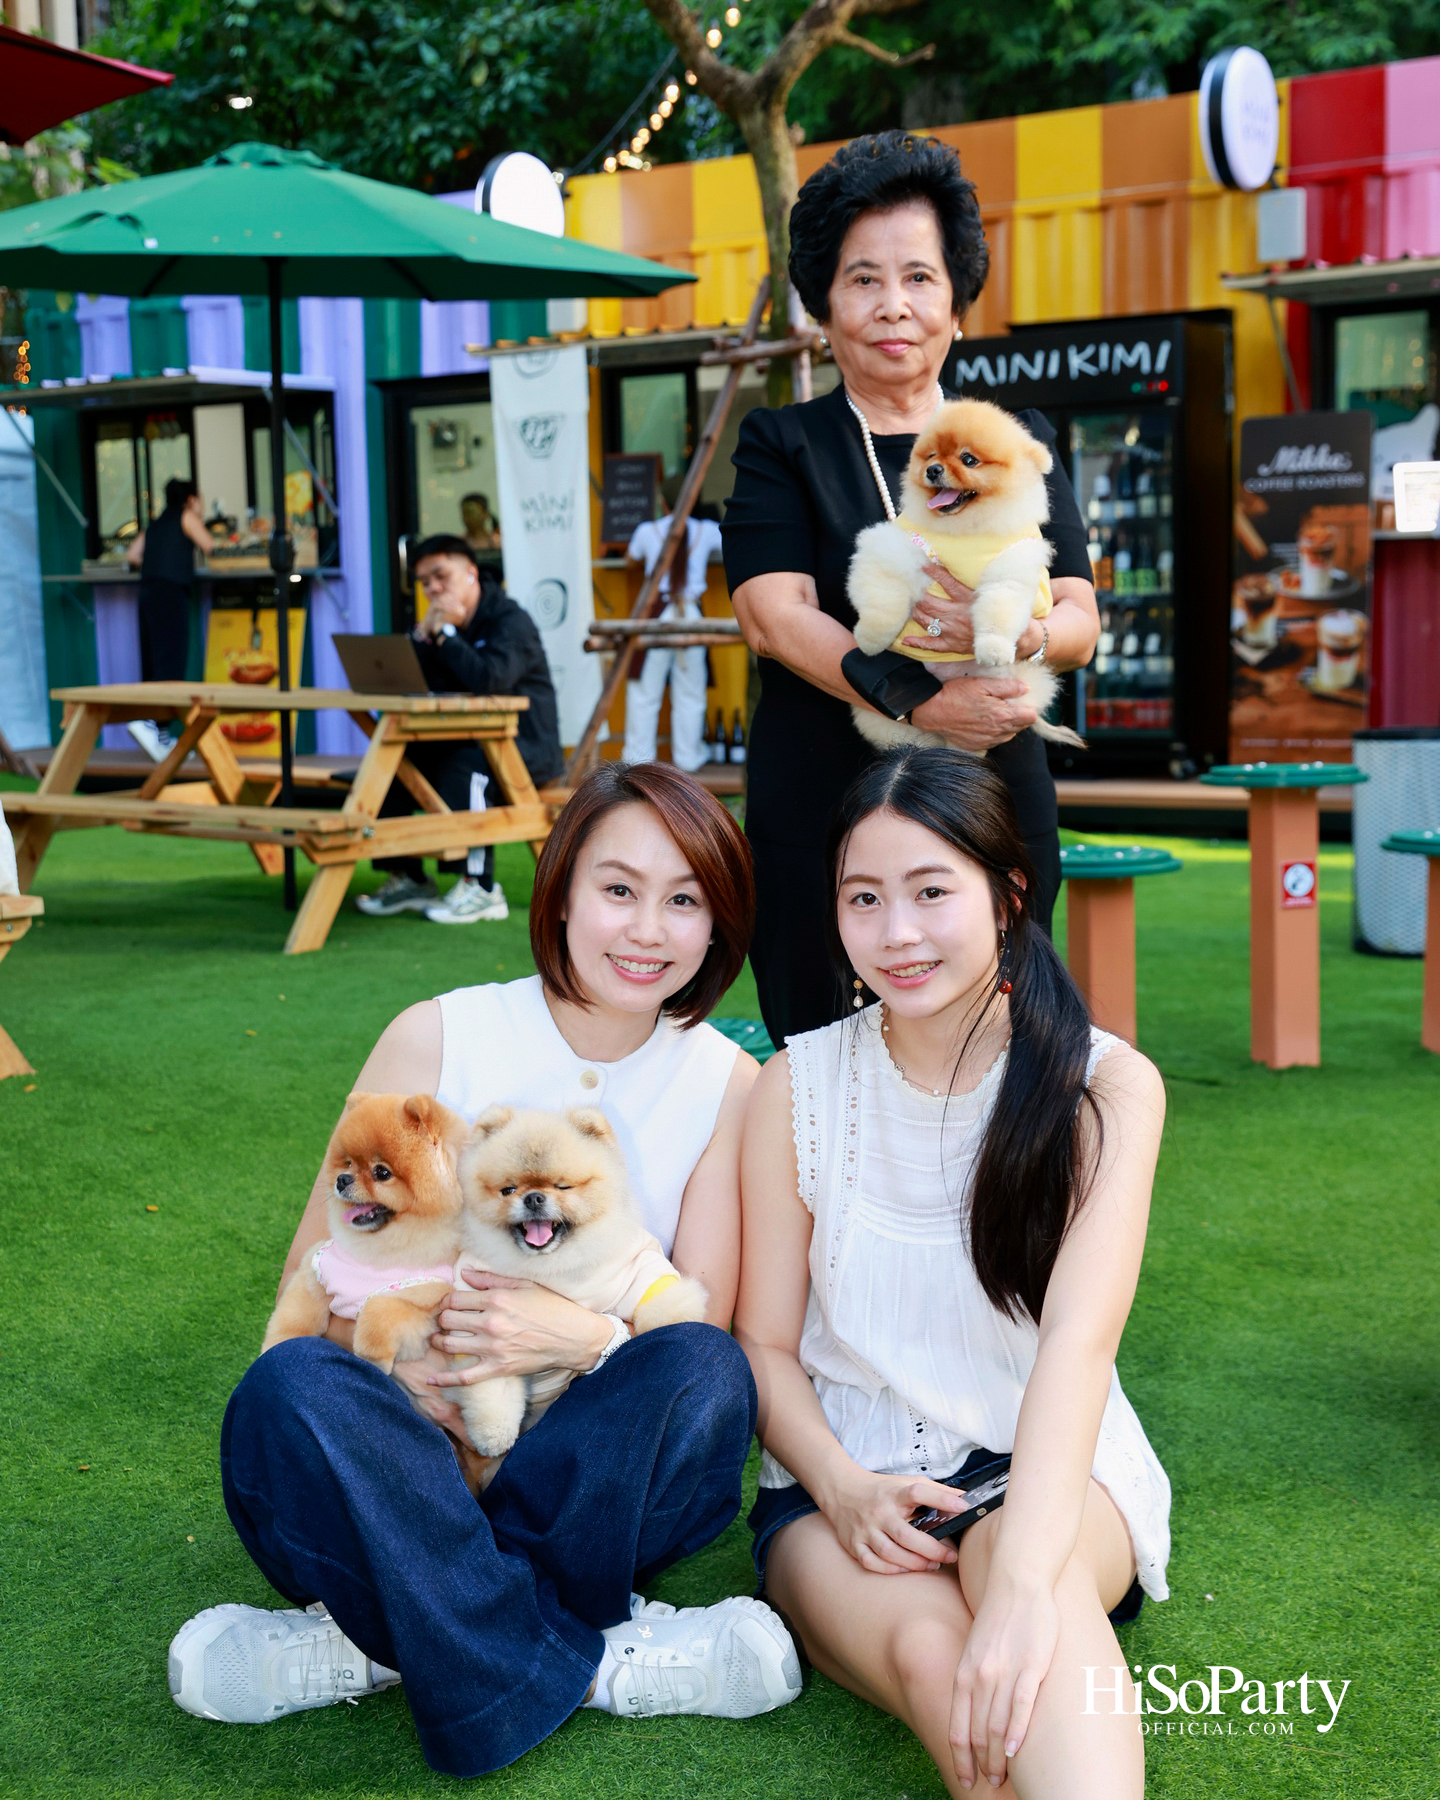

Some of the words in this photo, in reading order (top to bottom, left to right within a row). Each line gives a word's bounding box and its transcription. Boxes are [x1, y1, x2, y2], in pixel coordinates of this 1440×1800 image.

[955, 349, 1060, 388] MINI
[1067, 339, 1172, 380] KIMI
[519, 489, 575, 514] MINI
[524, 514, 574, 533] KIMI
